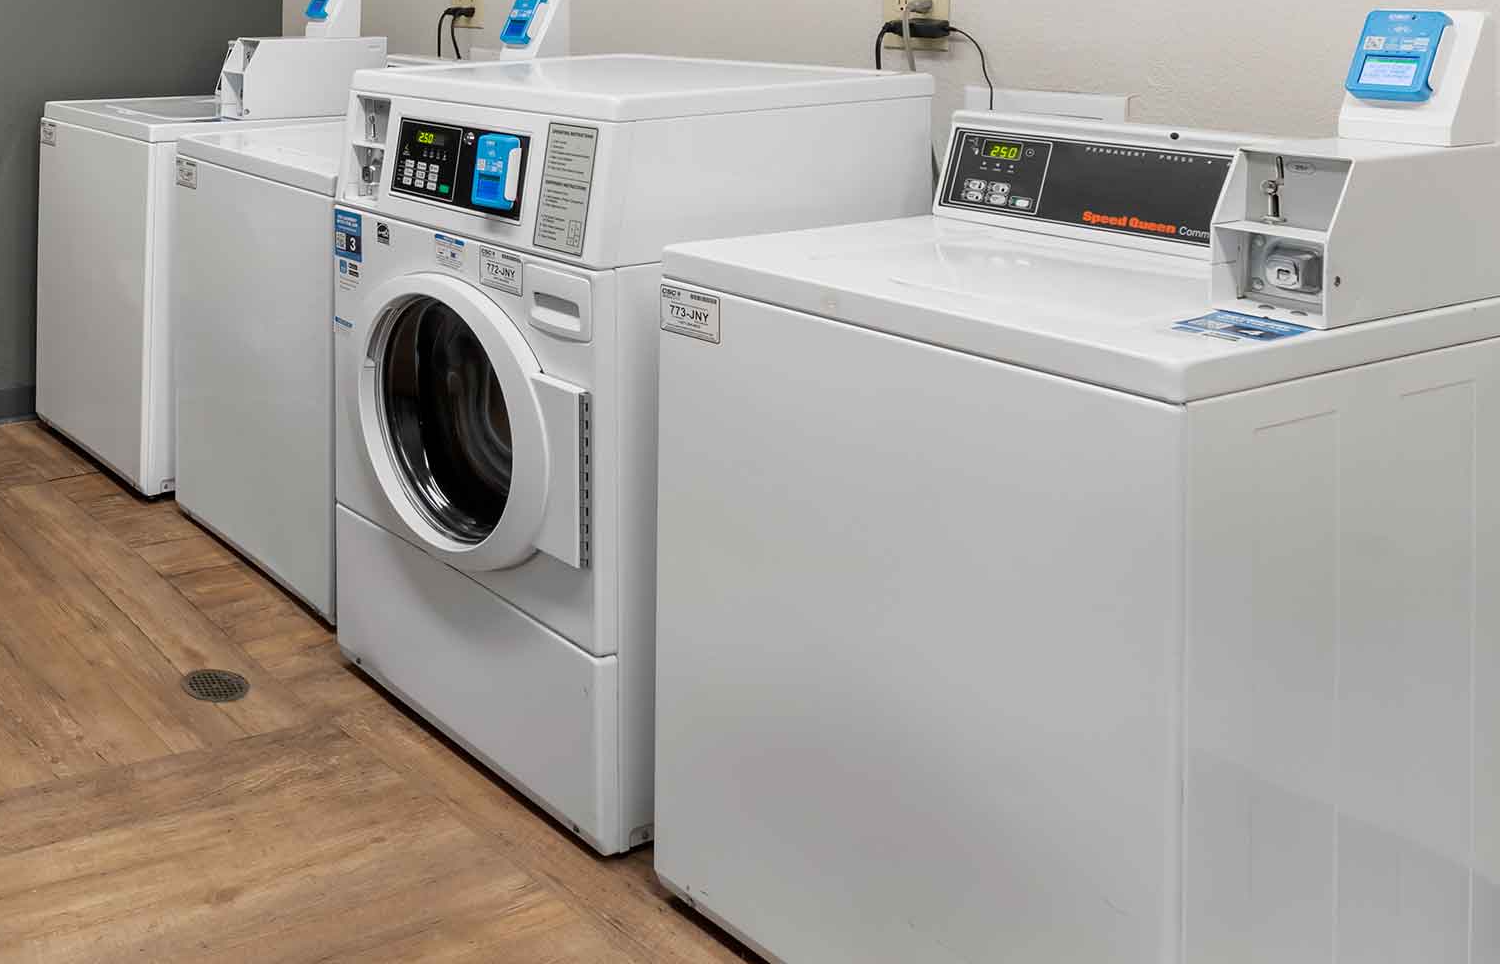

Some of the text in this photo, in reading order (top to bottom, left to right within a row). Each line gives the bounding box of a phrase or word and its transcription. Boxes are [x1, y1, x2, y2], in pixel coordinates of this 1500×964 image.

[990, 145, 1018, 158] 250
[1085, 146, 1195, 163] PERMANENT PRESS
[1082, 210, 1128, 227] Speed
[1129, 217, 1177, 234] Queen
[349, 237, 356, 252] 3
[487, 262, 515, 278] 772-JNY
[669, 304, 709, 323] 773-JNY
